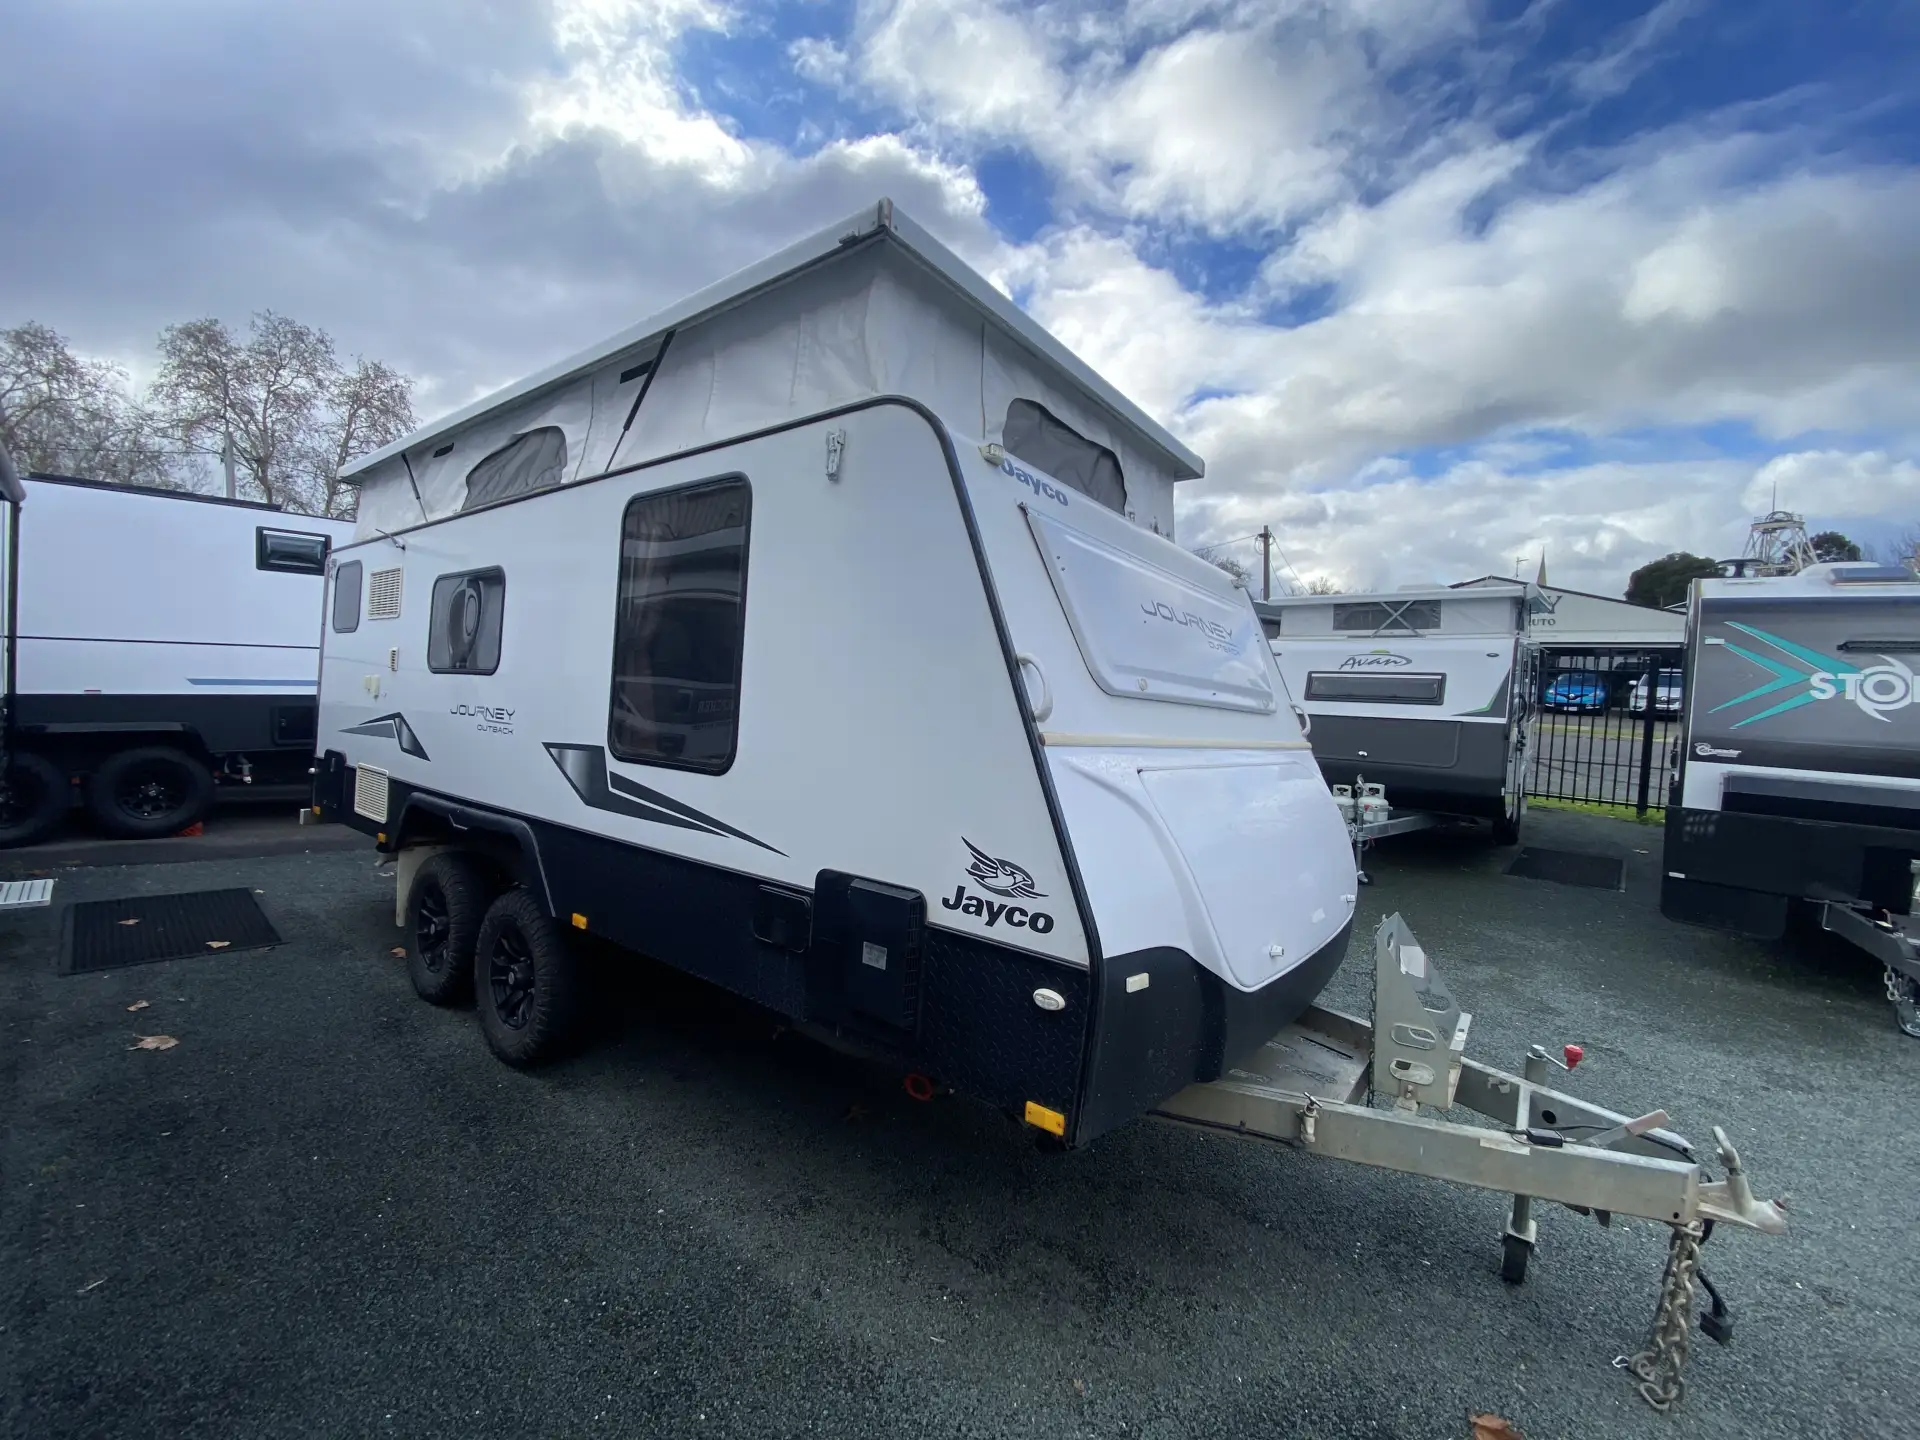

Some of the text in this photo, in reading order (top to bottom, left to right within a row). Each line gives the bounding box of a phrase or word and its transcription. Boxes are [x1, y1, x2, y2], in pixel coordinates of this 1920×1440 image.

[1001, 458, 1069, 507] Jayco
[1141, 600, 1233, 640] JOURNEY
[1529, 618, 1556, 626] UTO
[1338, 655, 1405, 670] Avan
[450, 704, 516, 722] JOURNEY
[477, 724, 514, 735] OUTBACK
[942, 885, 1055, 934] Jayco
